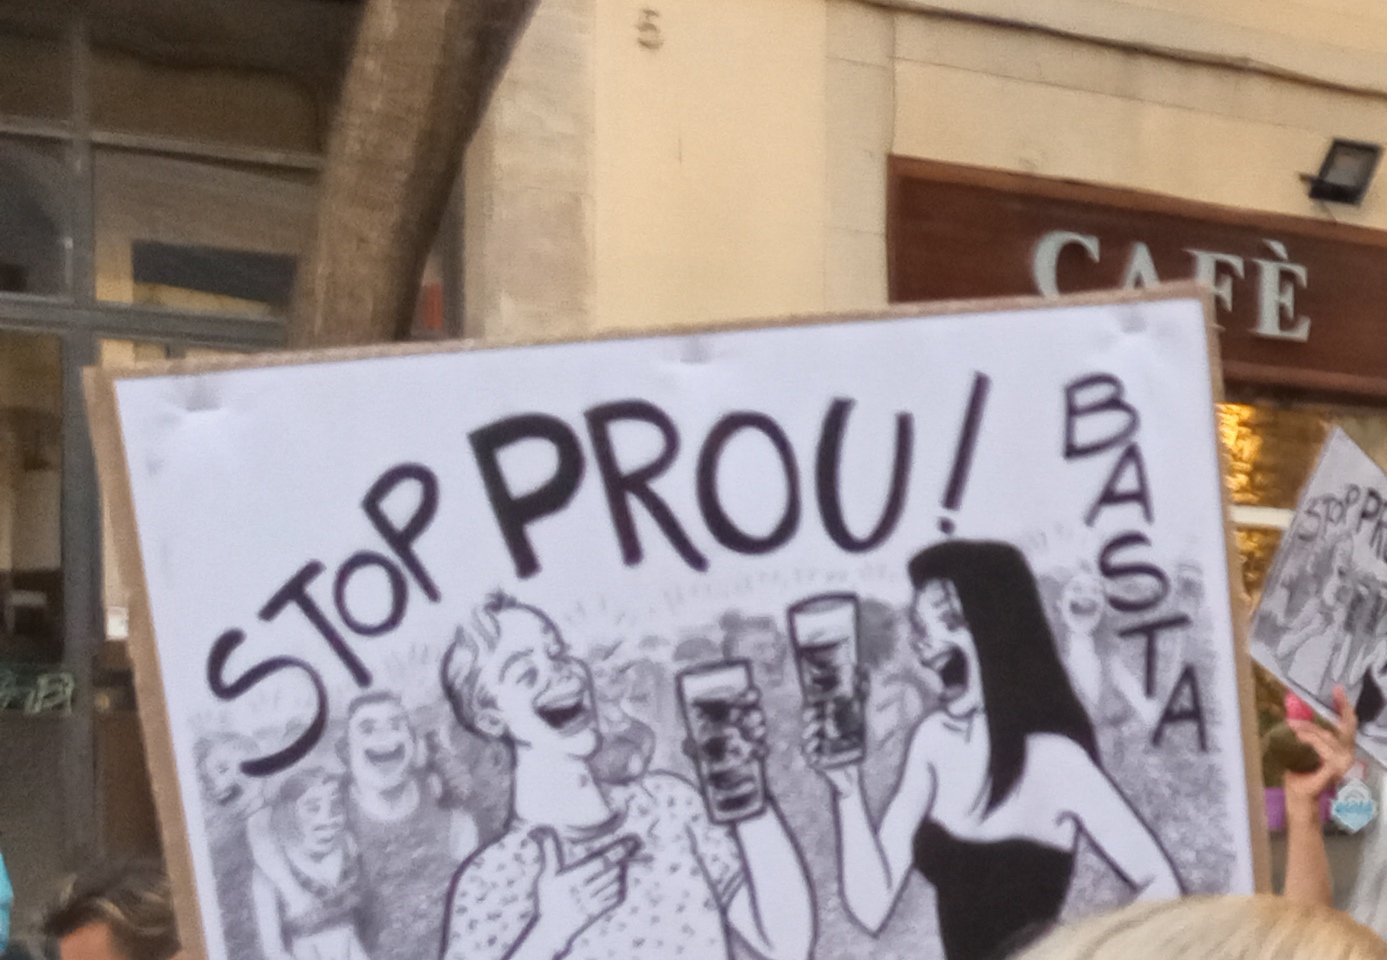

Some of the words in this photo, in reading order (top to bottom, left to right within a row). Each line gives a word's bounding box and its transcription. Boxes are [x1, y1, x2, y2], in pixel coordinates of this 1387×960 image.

[206, 461, 442, 777] STOP
[466, 371, 991, 579] PROU!
[1063, 372, 1209, 752] BASTA
